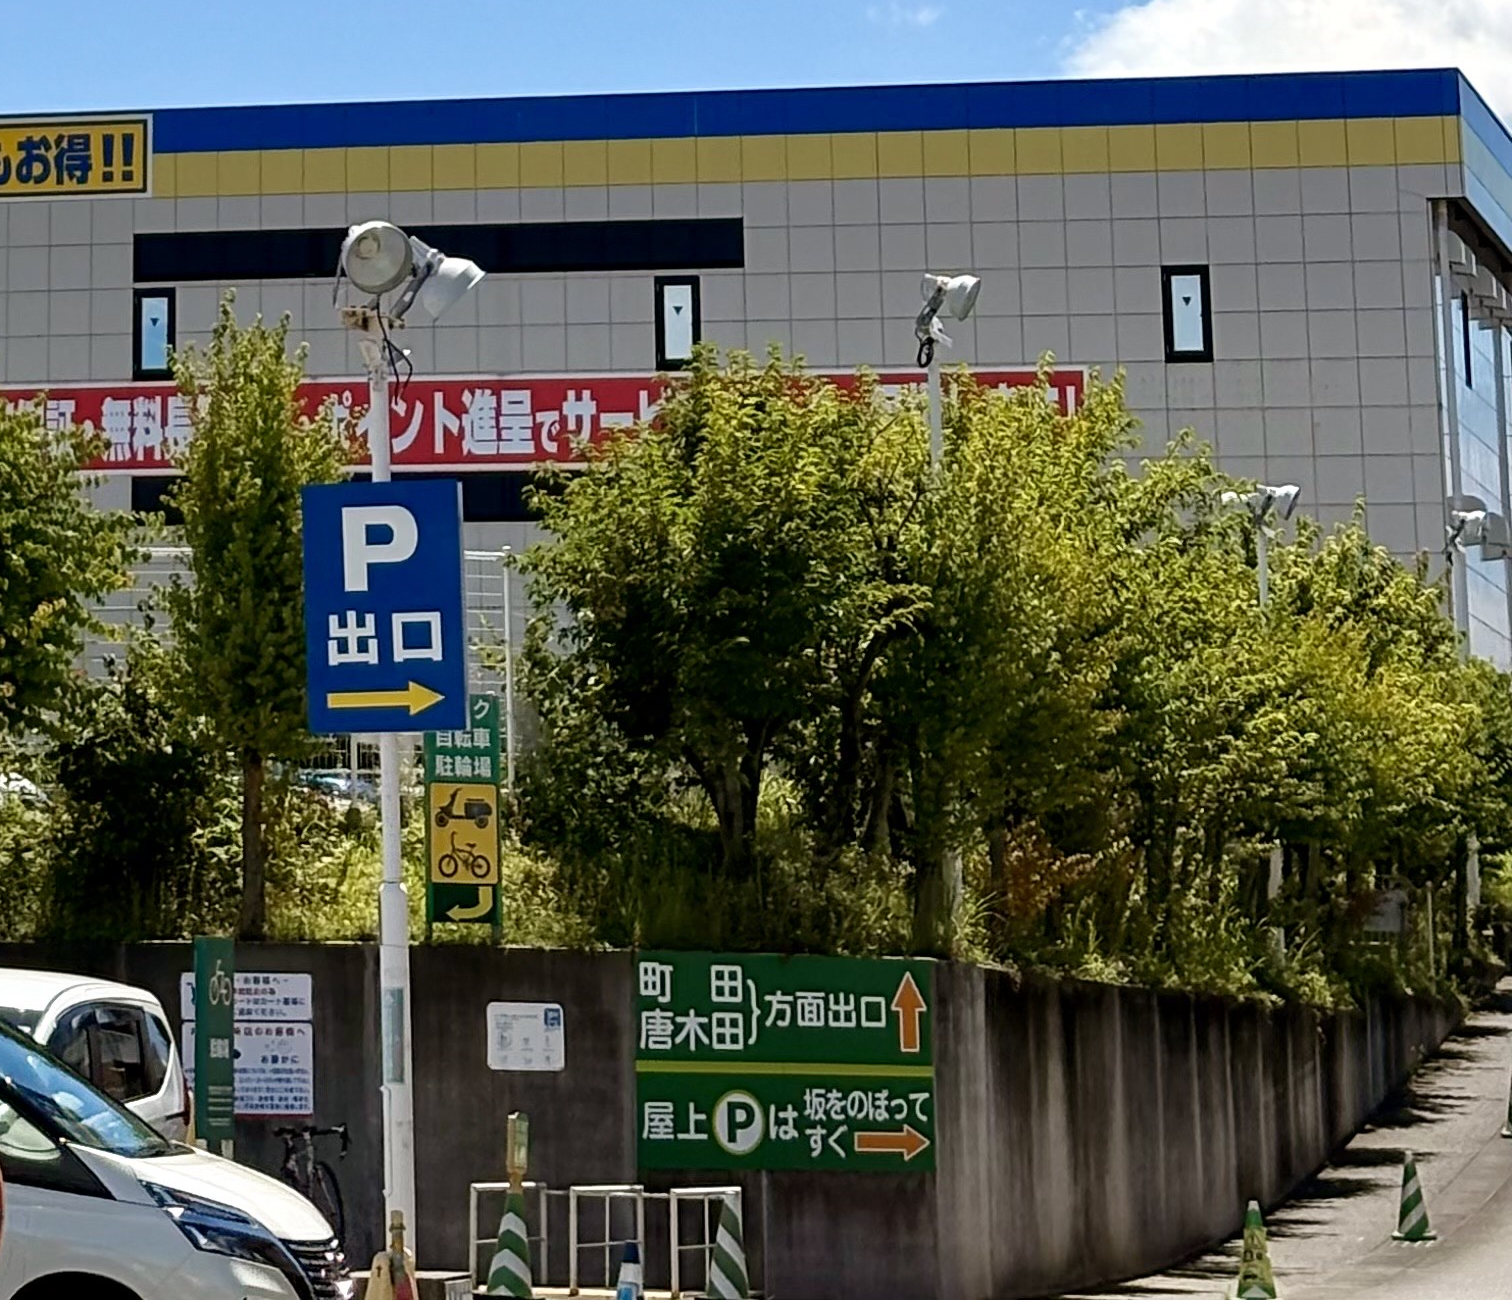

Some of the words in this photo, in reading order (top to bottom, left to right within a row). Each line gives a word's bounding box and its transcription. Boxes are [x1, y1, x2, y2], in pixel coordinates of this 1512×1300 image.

[342, 504, 418, 592] P
[328, 610, 443, 666] 出口
[473, 698, 490, 720] ク
[436, 727, 491, 749] 自転車
[435, 754, 492, 778] 駐輪場
[764, 990, 887, 1029] 方面出口
[640, 1008, 744, 1051] 唐木田
[803, 1088, 930, 1121] 坂をのぼって
[805, 1125, 848, 1158] すぐ
